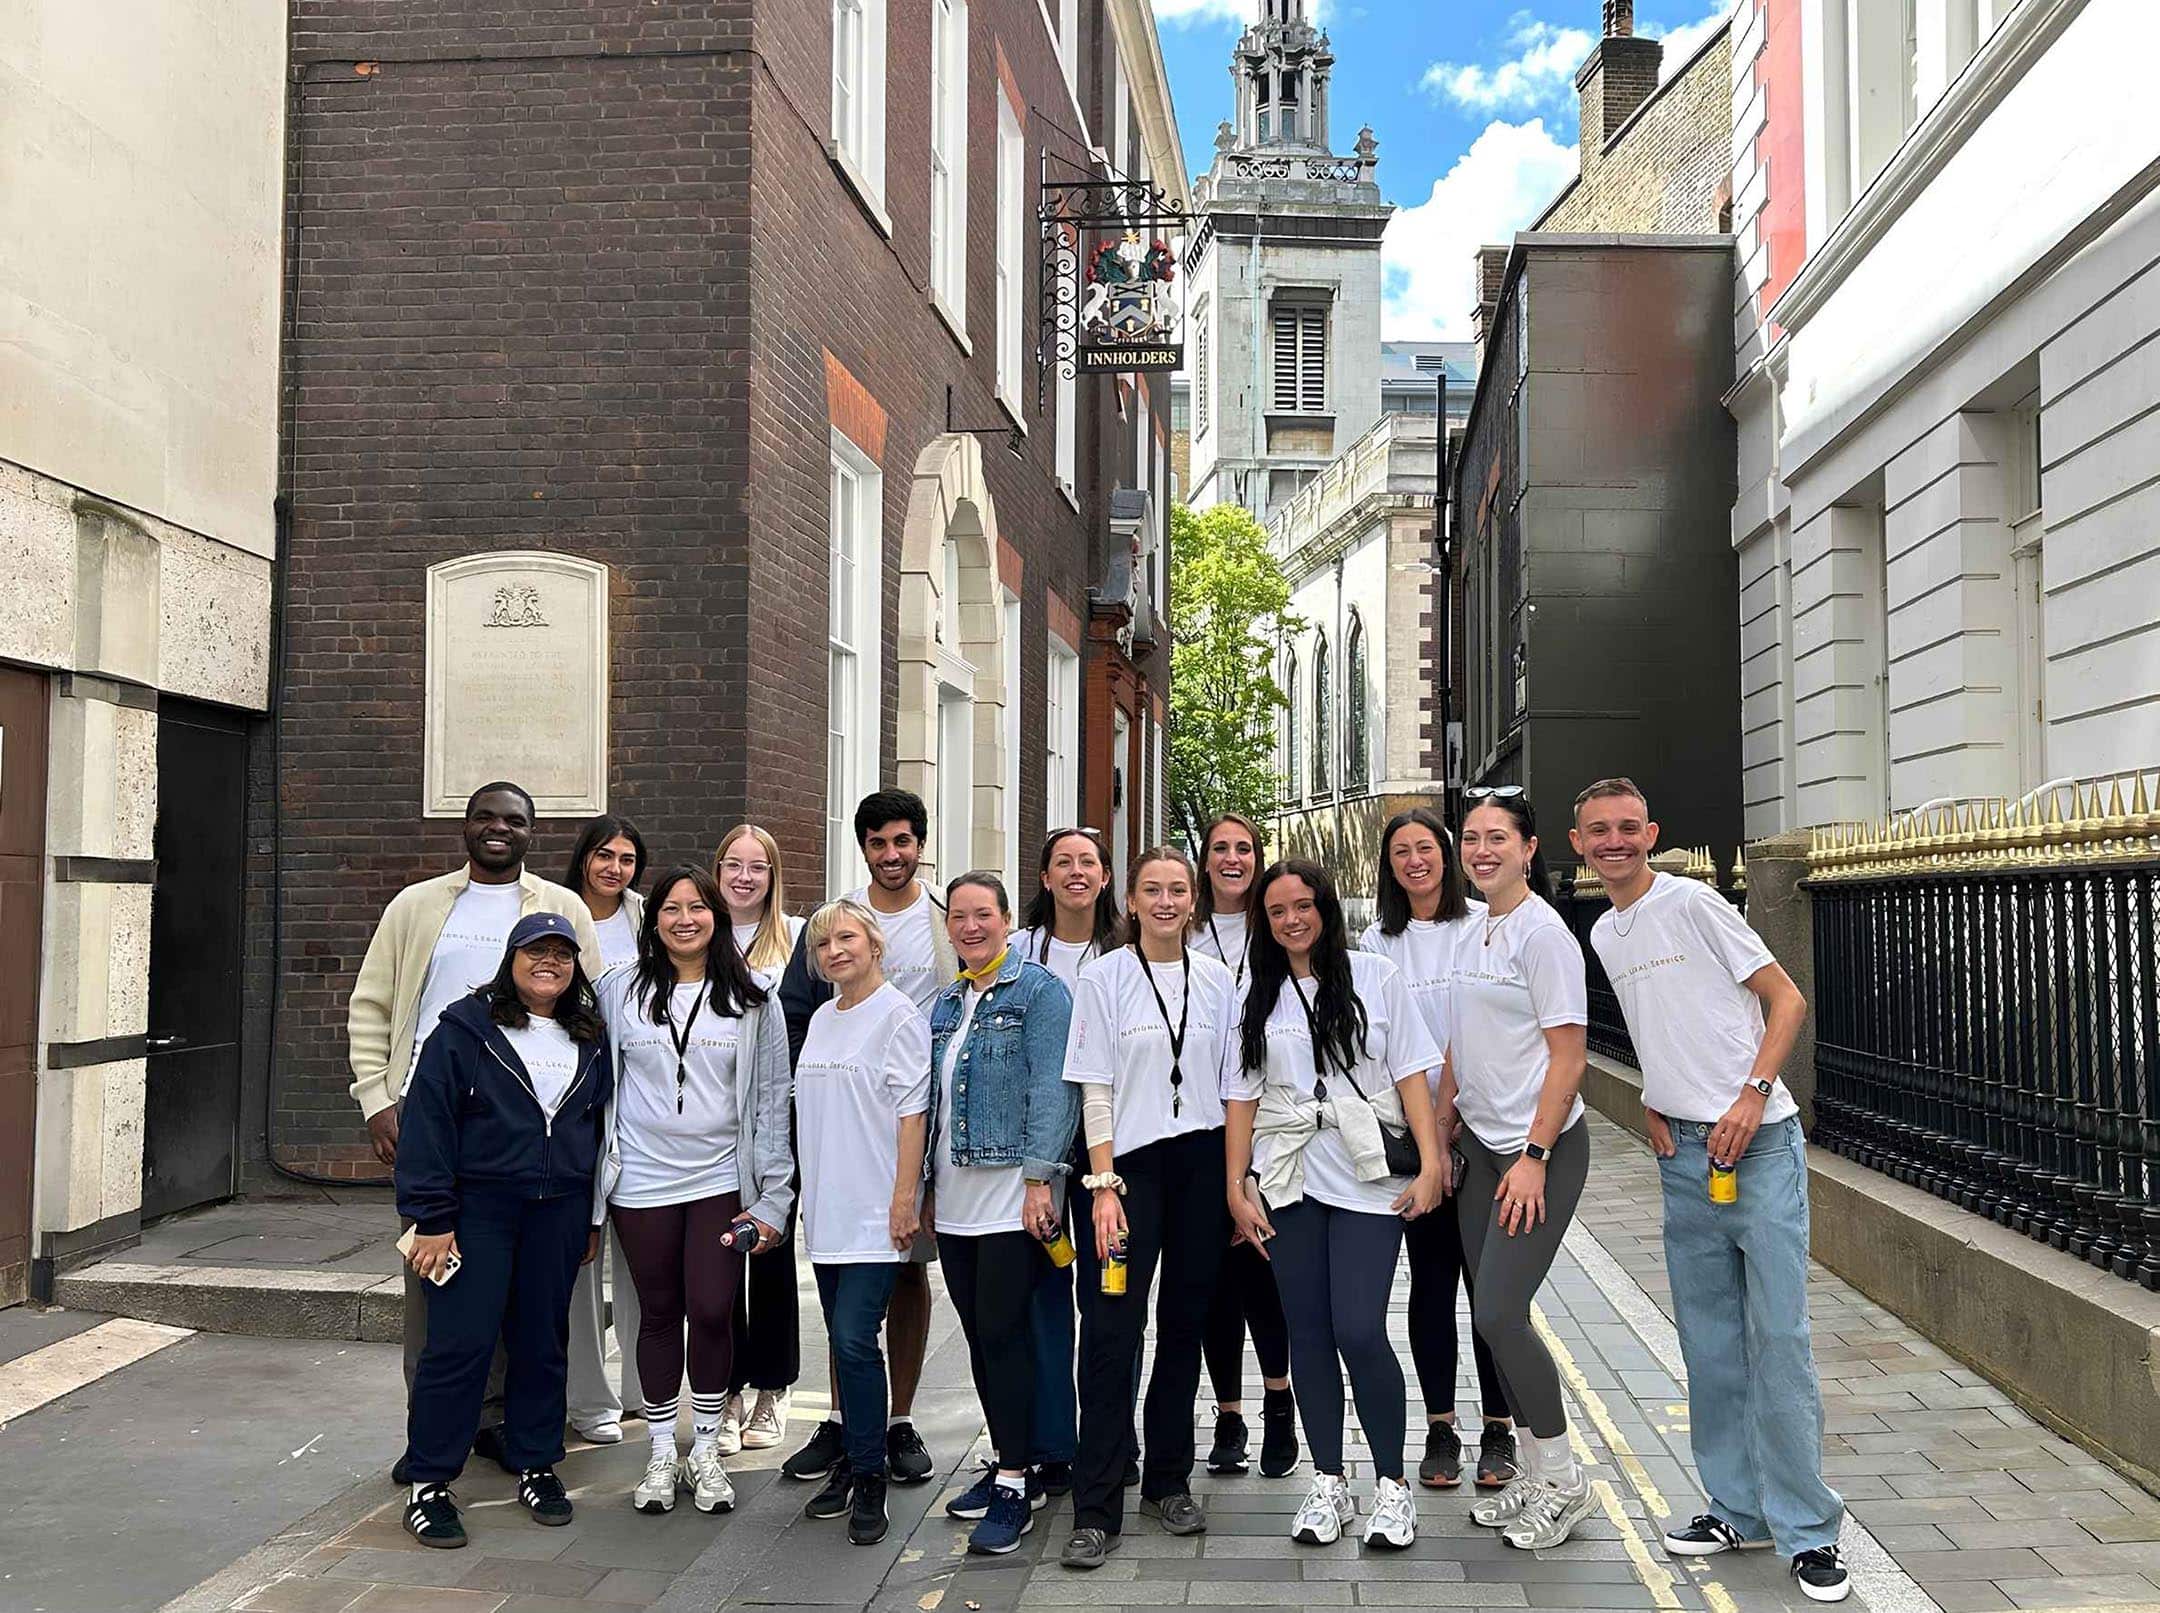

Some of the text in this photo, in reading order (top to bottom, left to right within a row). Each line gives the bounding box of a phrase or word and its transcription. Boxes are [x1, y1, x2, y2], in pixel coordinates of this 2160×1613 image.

[1087, 351, 1177, 366] INNHOLDERS
[1650, 954, 1686, 968] SERVICE
[1120, 1022, 1163, 1039] NATIONAL
[1266, 1028, 1302, 1039] ATIONAL
[700, 1038, 736, 1049] SERVICE
[829, 1060, 859, 1073] SERVICE
